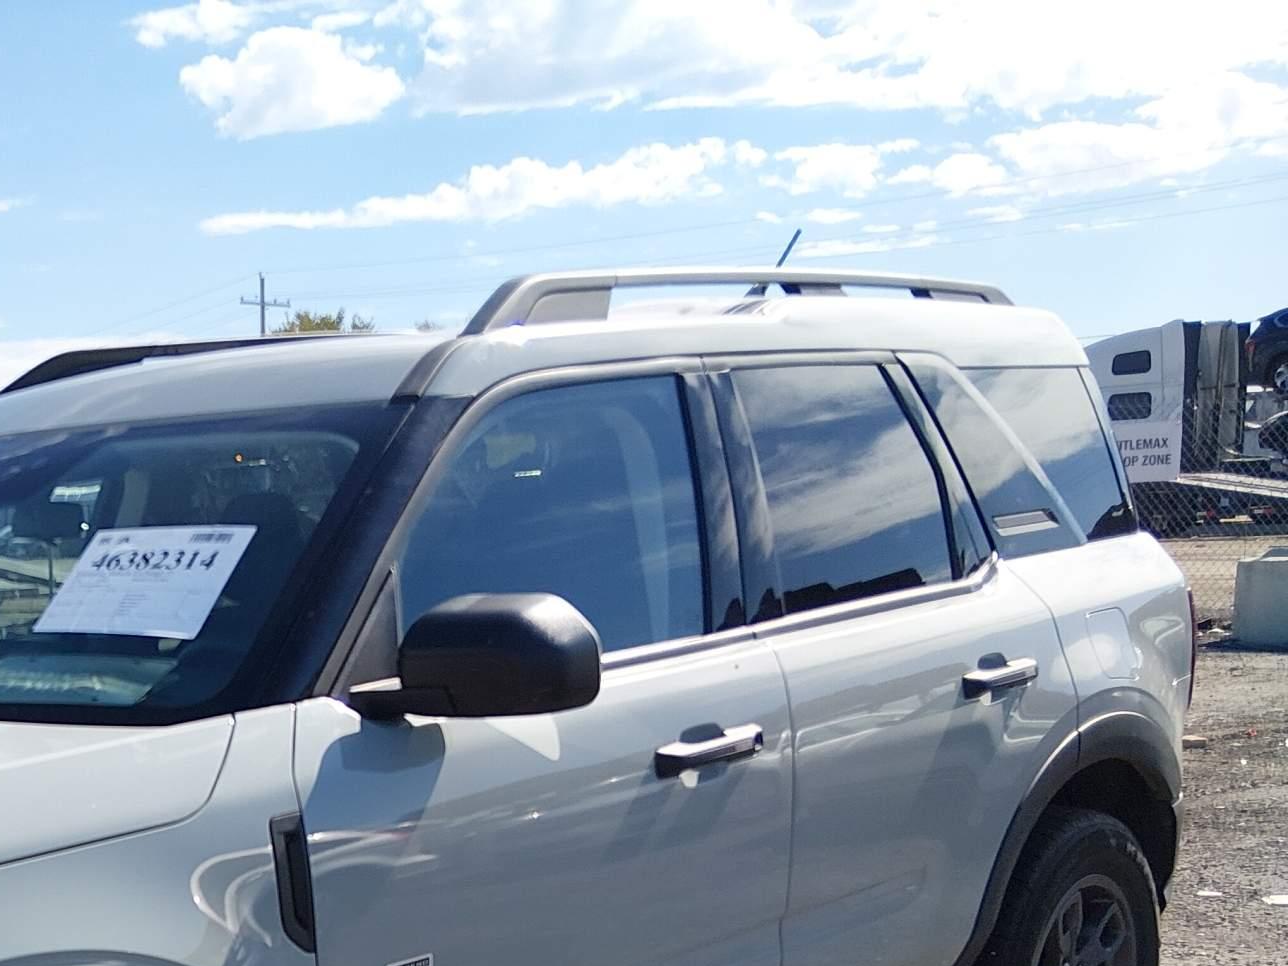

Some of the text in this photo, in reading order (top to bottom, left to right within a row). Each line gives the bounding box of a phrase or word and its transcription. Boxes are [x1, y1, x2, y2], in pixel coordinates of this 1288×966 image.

[1123, 453, 1172, 467] OP ZONE
[92, 550, 219, 571] 46382314
